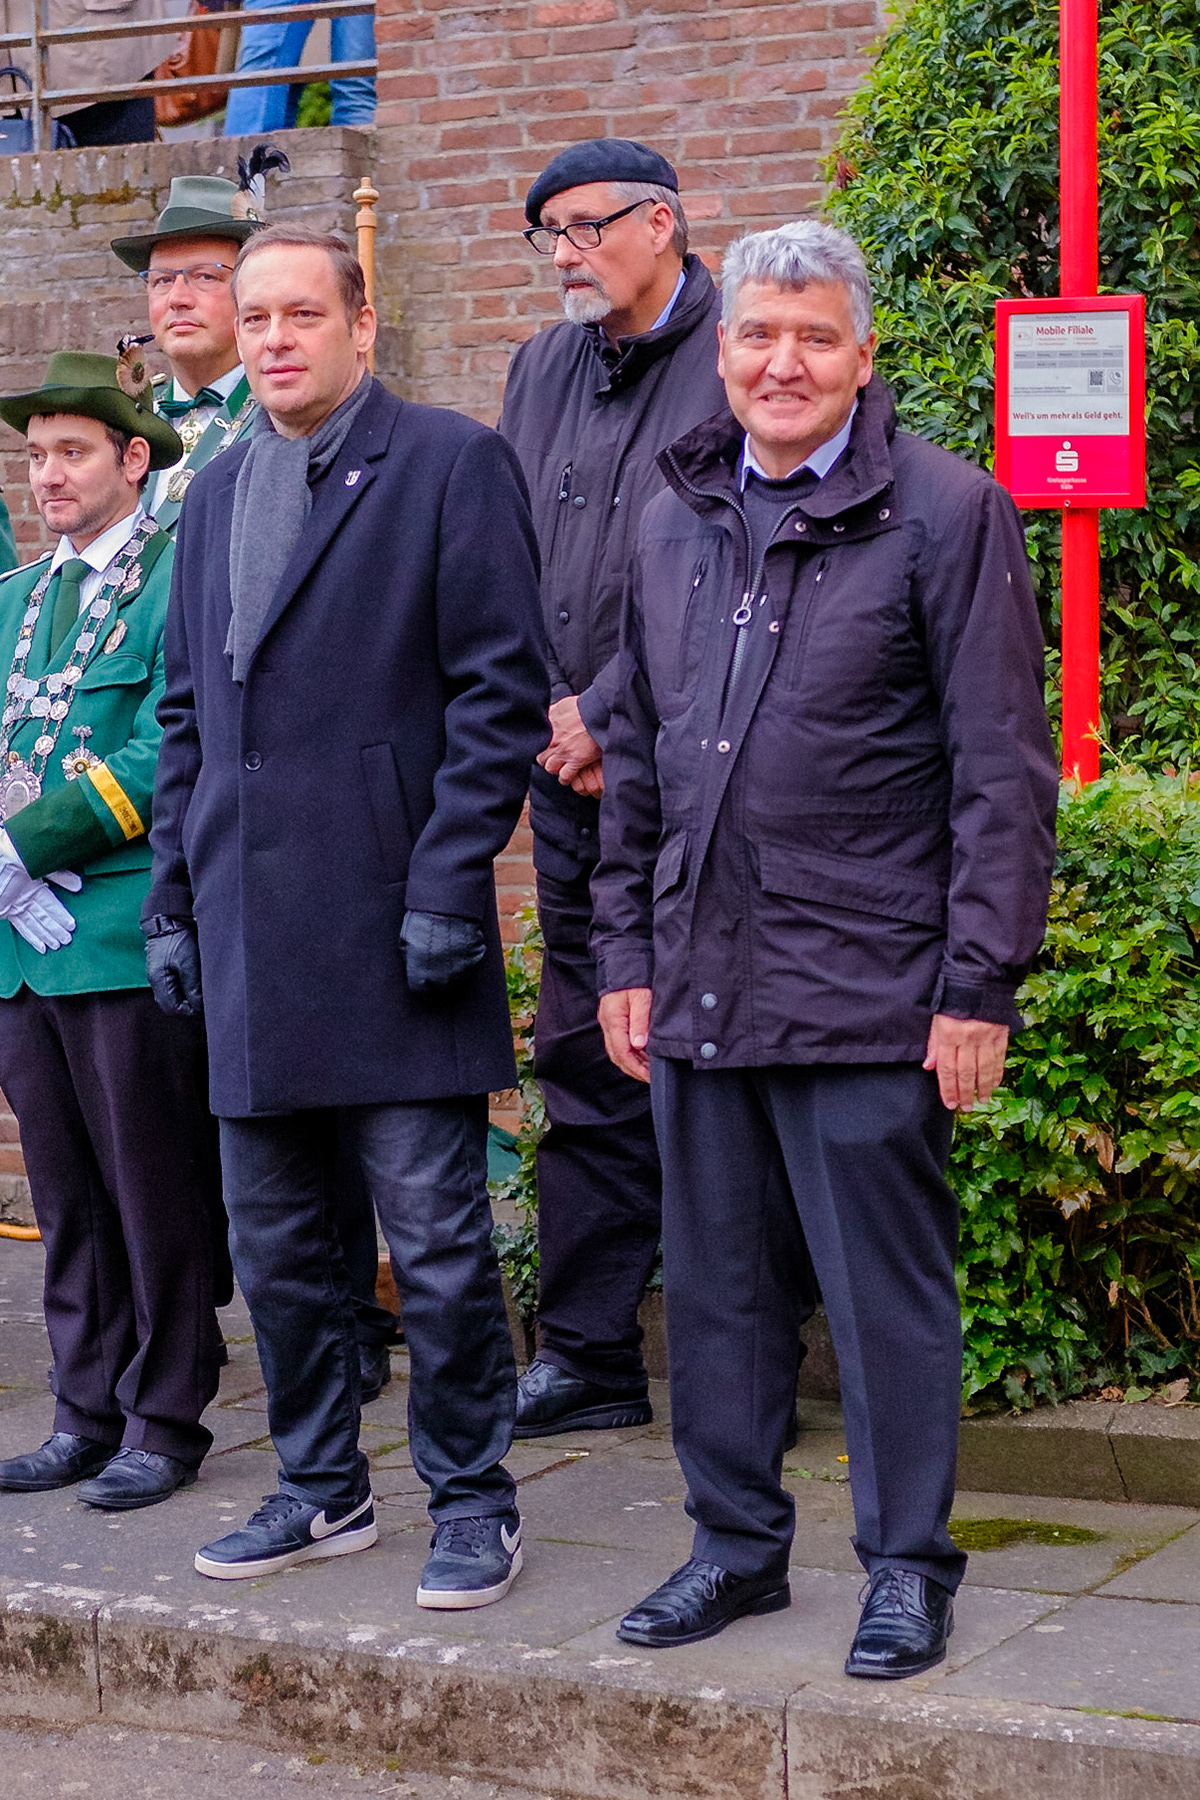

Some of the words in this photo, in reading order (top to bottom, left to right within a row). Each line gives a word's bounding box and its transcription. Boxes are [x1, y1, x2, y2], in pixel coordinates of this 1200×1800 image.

[1036, 325, 1066, 335] Mobile
[1067, 325, 1094, 335] Filiale
[1012, 412, 1035, 420] Weil's
[1050, 412, 1070, 420] mehr
[1071, 411, 1082, 419] als
[1084, 411, 1101, 419] Geld
[1103, 411, 1123, 421] geht.
